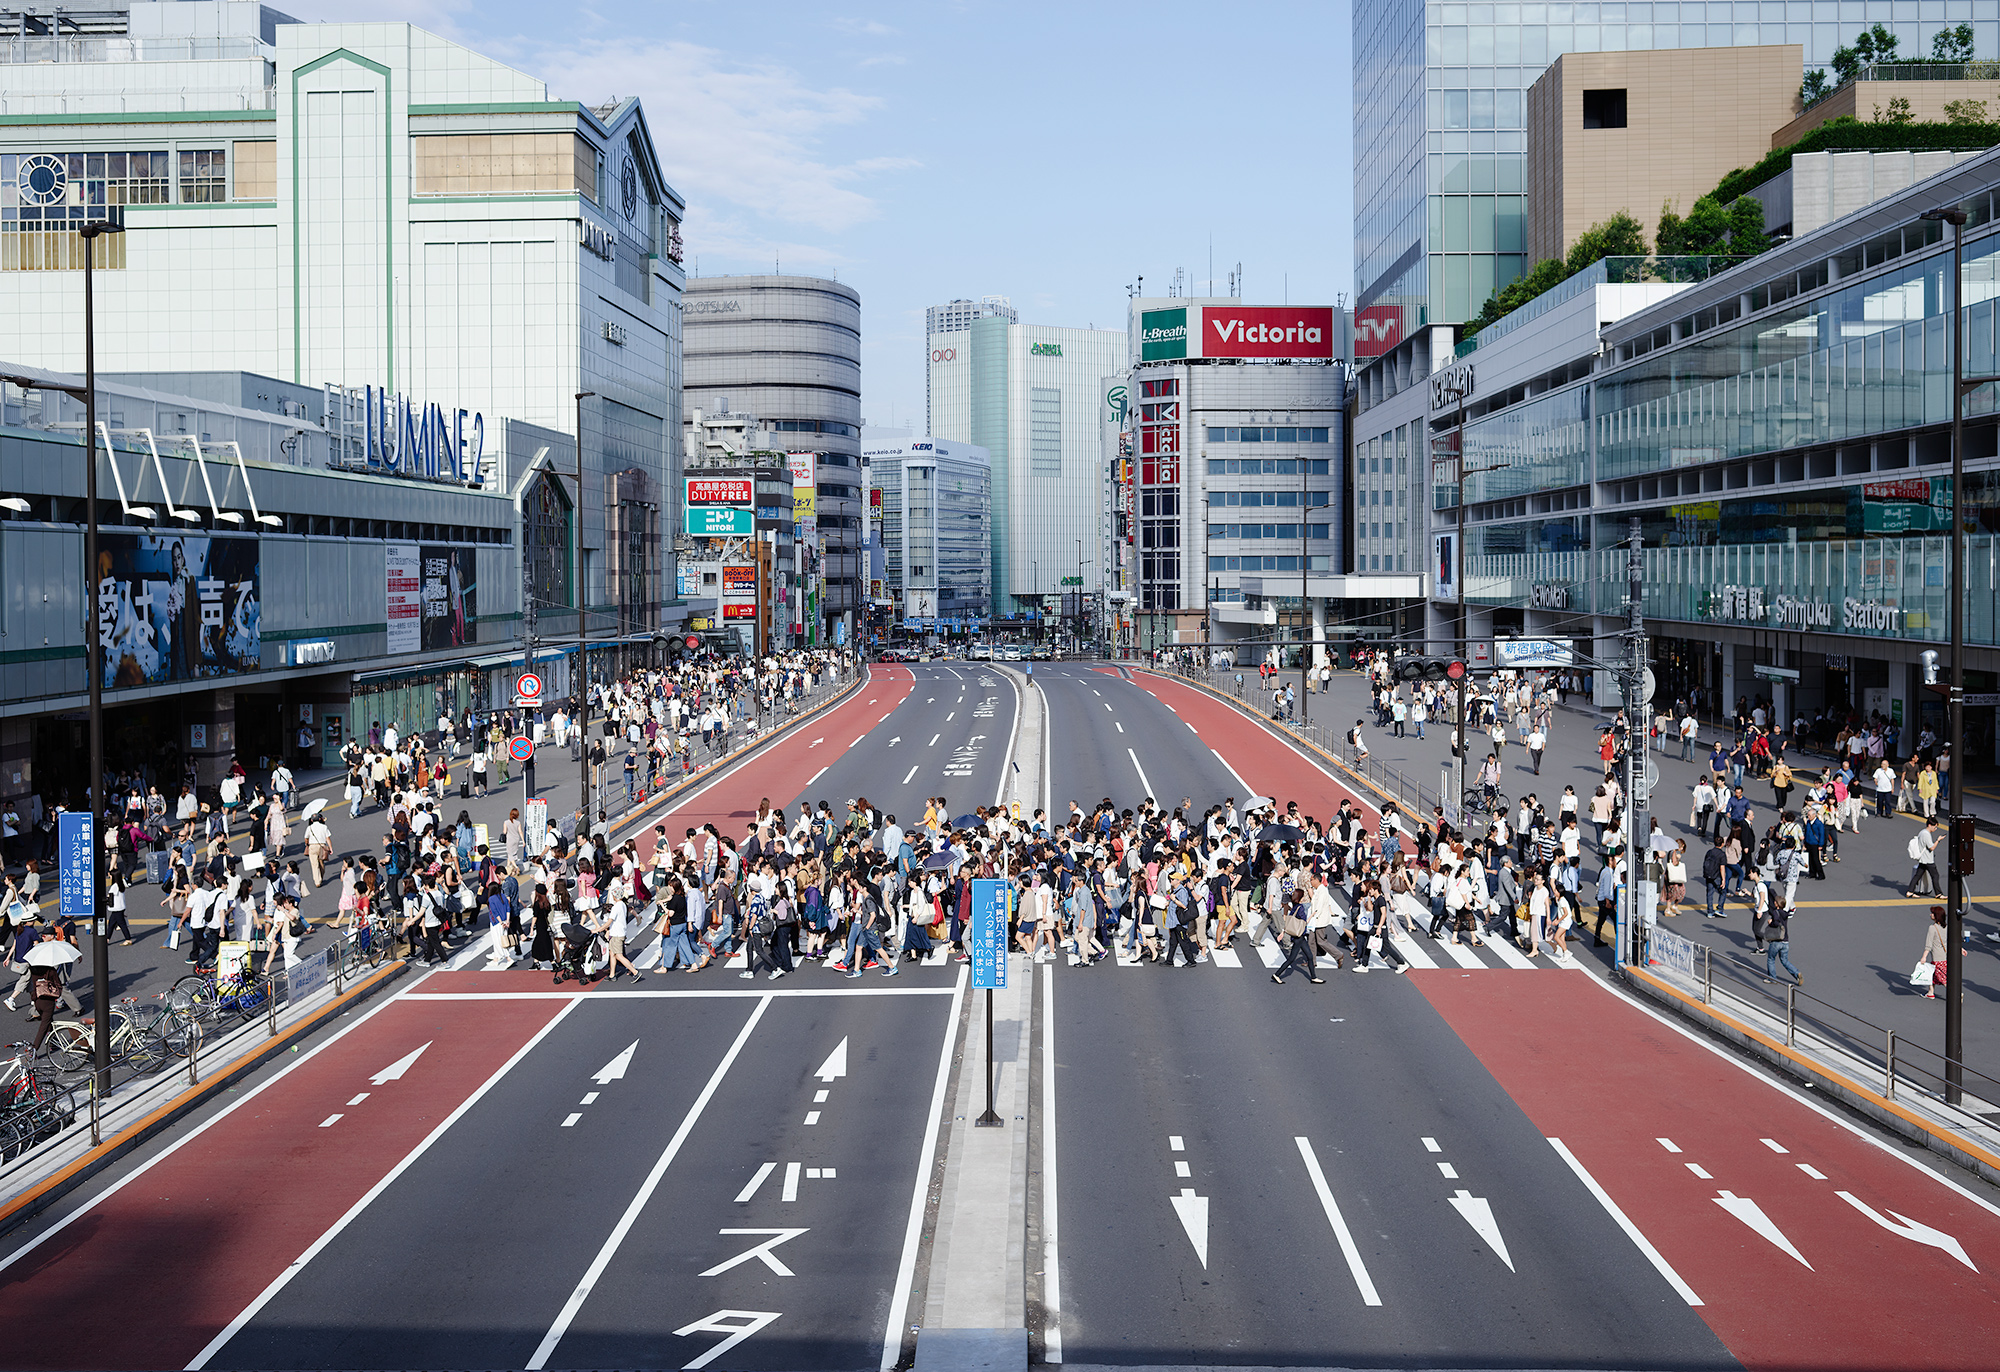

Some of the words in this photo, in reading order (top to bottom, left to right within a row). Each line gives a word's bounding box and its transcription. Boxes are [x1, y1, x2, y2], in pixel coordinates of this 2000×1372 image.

[1212, 319, 1321, 344] Victoria
[363, 384, 468, 481] LUMINE
[471, 411, 485, 483] 2
[863, 448, 903, 456] www.keio.co.jp
[912, 443, 933, 451] KEIO
[705, 510, 735, 523] ニトリ
[1530, 584, 1567, 609] NEWoMan
[1723, 585, 1765, 621] 新宿駅
[1776, 593, 1831, 632] Shinjuku
[1843, 596, 1898, 631] Station
[1505, 642, 1566, 655] 新宿駅南口
[1514, 653, 1543, 663] Shinjuku
[71, 833, 82, 895] バスタ新宿へは
[81, 816, 92, 906] 一般車・原付・自転車は
[62, 868, 73, 913] 入れません
[984, 901, 995, 967] バスタ新宿へは
[995, 883, 1005, 986] 一般車・貸切バス・大型貨物車は
[974, 938, 985, 986] 入れません
